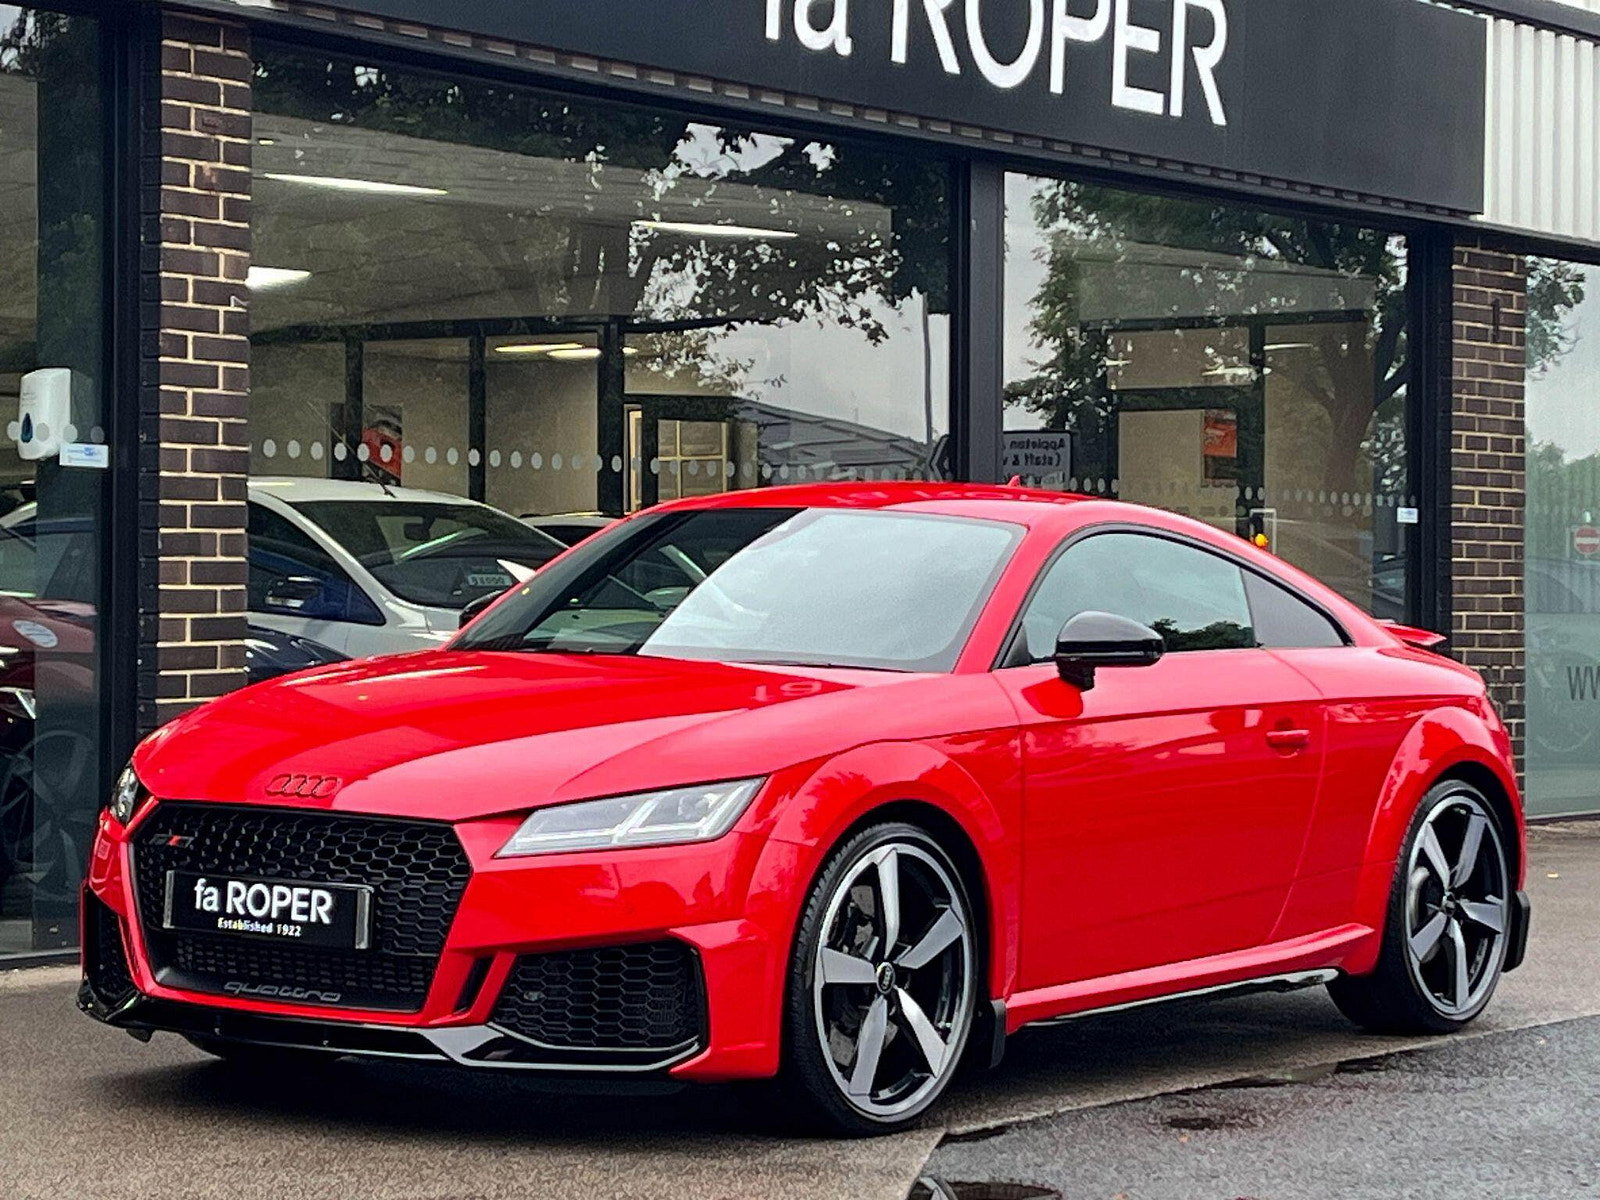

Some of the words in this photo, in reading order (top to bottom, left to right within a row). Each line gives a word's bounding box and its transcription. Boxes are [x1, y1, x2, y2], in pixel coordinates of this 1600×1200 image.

[890, 0, 1228, 126] ROPER
[194, 878, 219, 912] fa
[226, 880, 334, 924] ROPER
[217, 917, 274, 934] Established
[276, 924, 302, 937] 1922
[223, 981, 341, 1002] quattro
